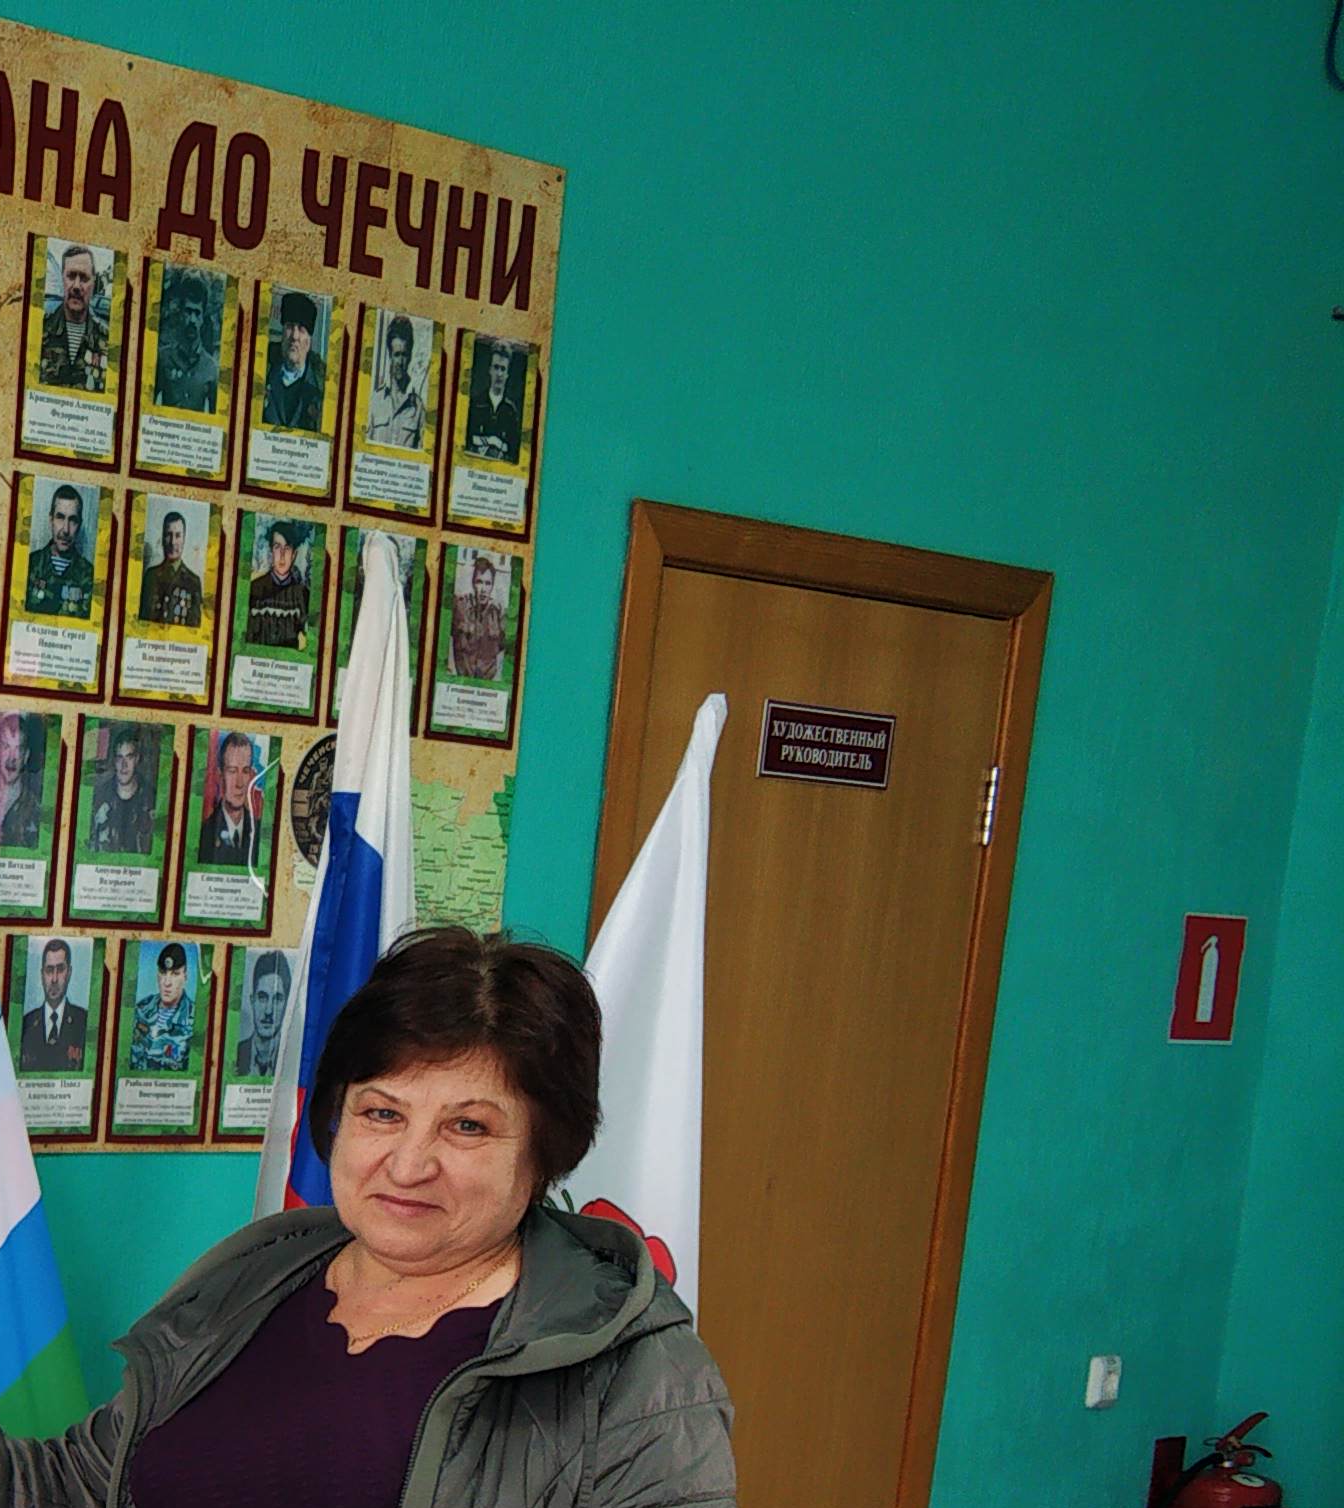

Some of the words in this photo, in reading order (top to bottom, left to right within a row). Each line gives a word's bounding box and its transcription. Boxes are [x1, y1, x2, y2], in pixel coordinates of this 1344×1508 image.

[157, 121, 270, 260] ДО
[301, 148, 537, 311] ЧЕЧНИ
[771, 720, 887, 750] ХУДОЖЕСТВЕННЫЙ
[780, 744, 873, 771] РУКОВОДИТЕЛЬ
